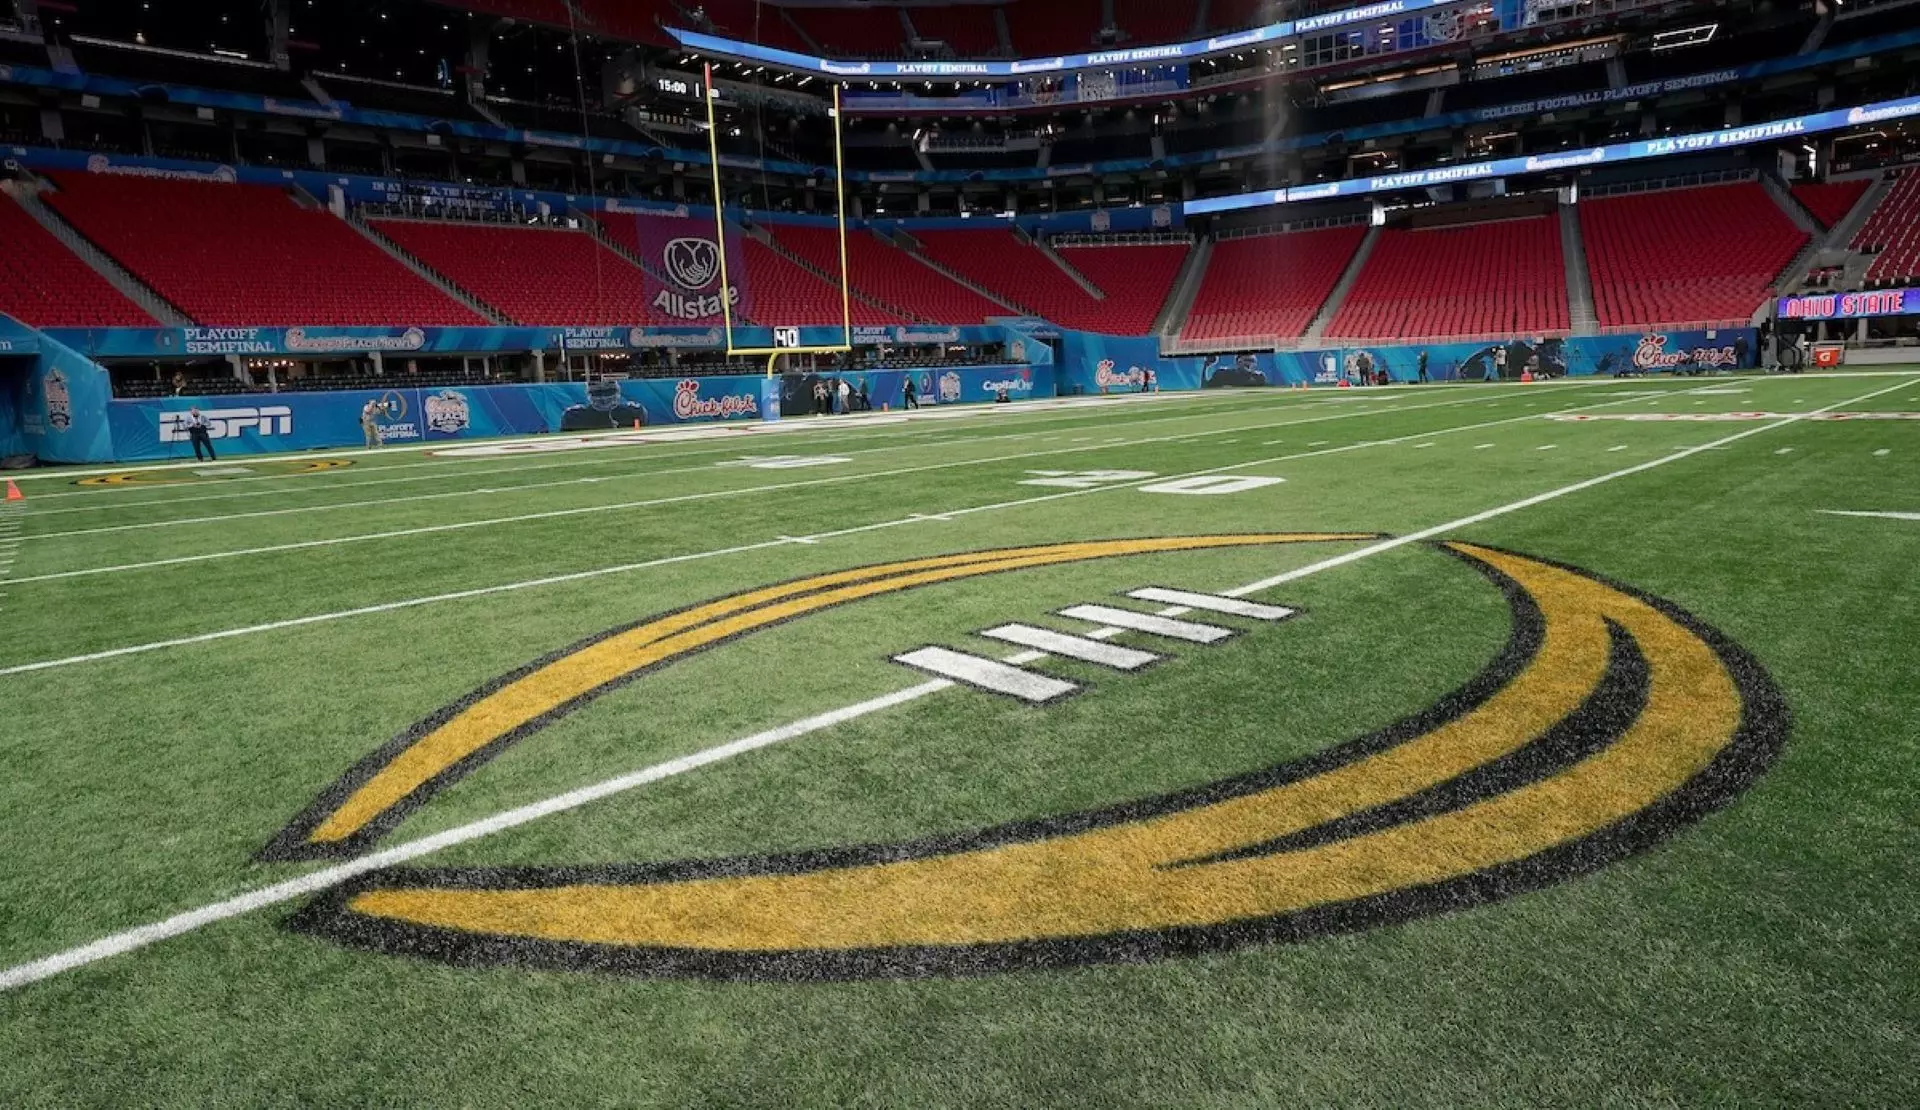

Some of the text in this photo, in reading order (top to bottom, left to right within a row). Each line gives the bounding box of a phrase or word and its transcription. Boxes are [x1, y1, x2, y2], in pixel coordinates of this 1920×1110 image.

[1296, 2, 1404, 32] PLAYOFF SEMIFINAL
[1088, 47, 1183, 64] PLAYOFF SEMIFINAL
[896, 61, 988, 73] PLAYOFF SEMIFINAL
[658, 79, 687, 95] 15:00
[1482, 70, 1739, 120] COLLEGE FOOTBALL PLAYOFF SEMIFINAL
[1647, 120, 1805, 154] PLAYOFF SEMIFINAL
[1371, 163, 1493, 189] PLAYOFF SEMIFINAL
[1786, 291, 1903, 318] OHIO STATE
[184, 328, 259, 341] PLAYOFF
[565, 327, 614, 338] PLAYOFF
[775, 329, 798, 348] 40
[186, 341, 275, 354] SEMIFINAL
[566, 338, 624, 349] SEMIFINAL
[1819, 351, 1831, 362] G
[674, 379, 757, 418] Chick-fil-A
[159, 405, 292, 442] ESPN
